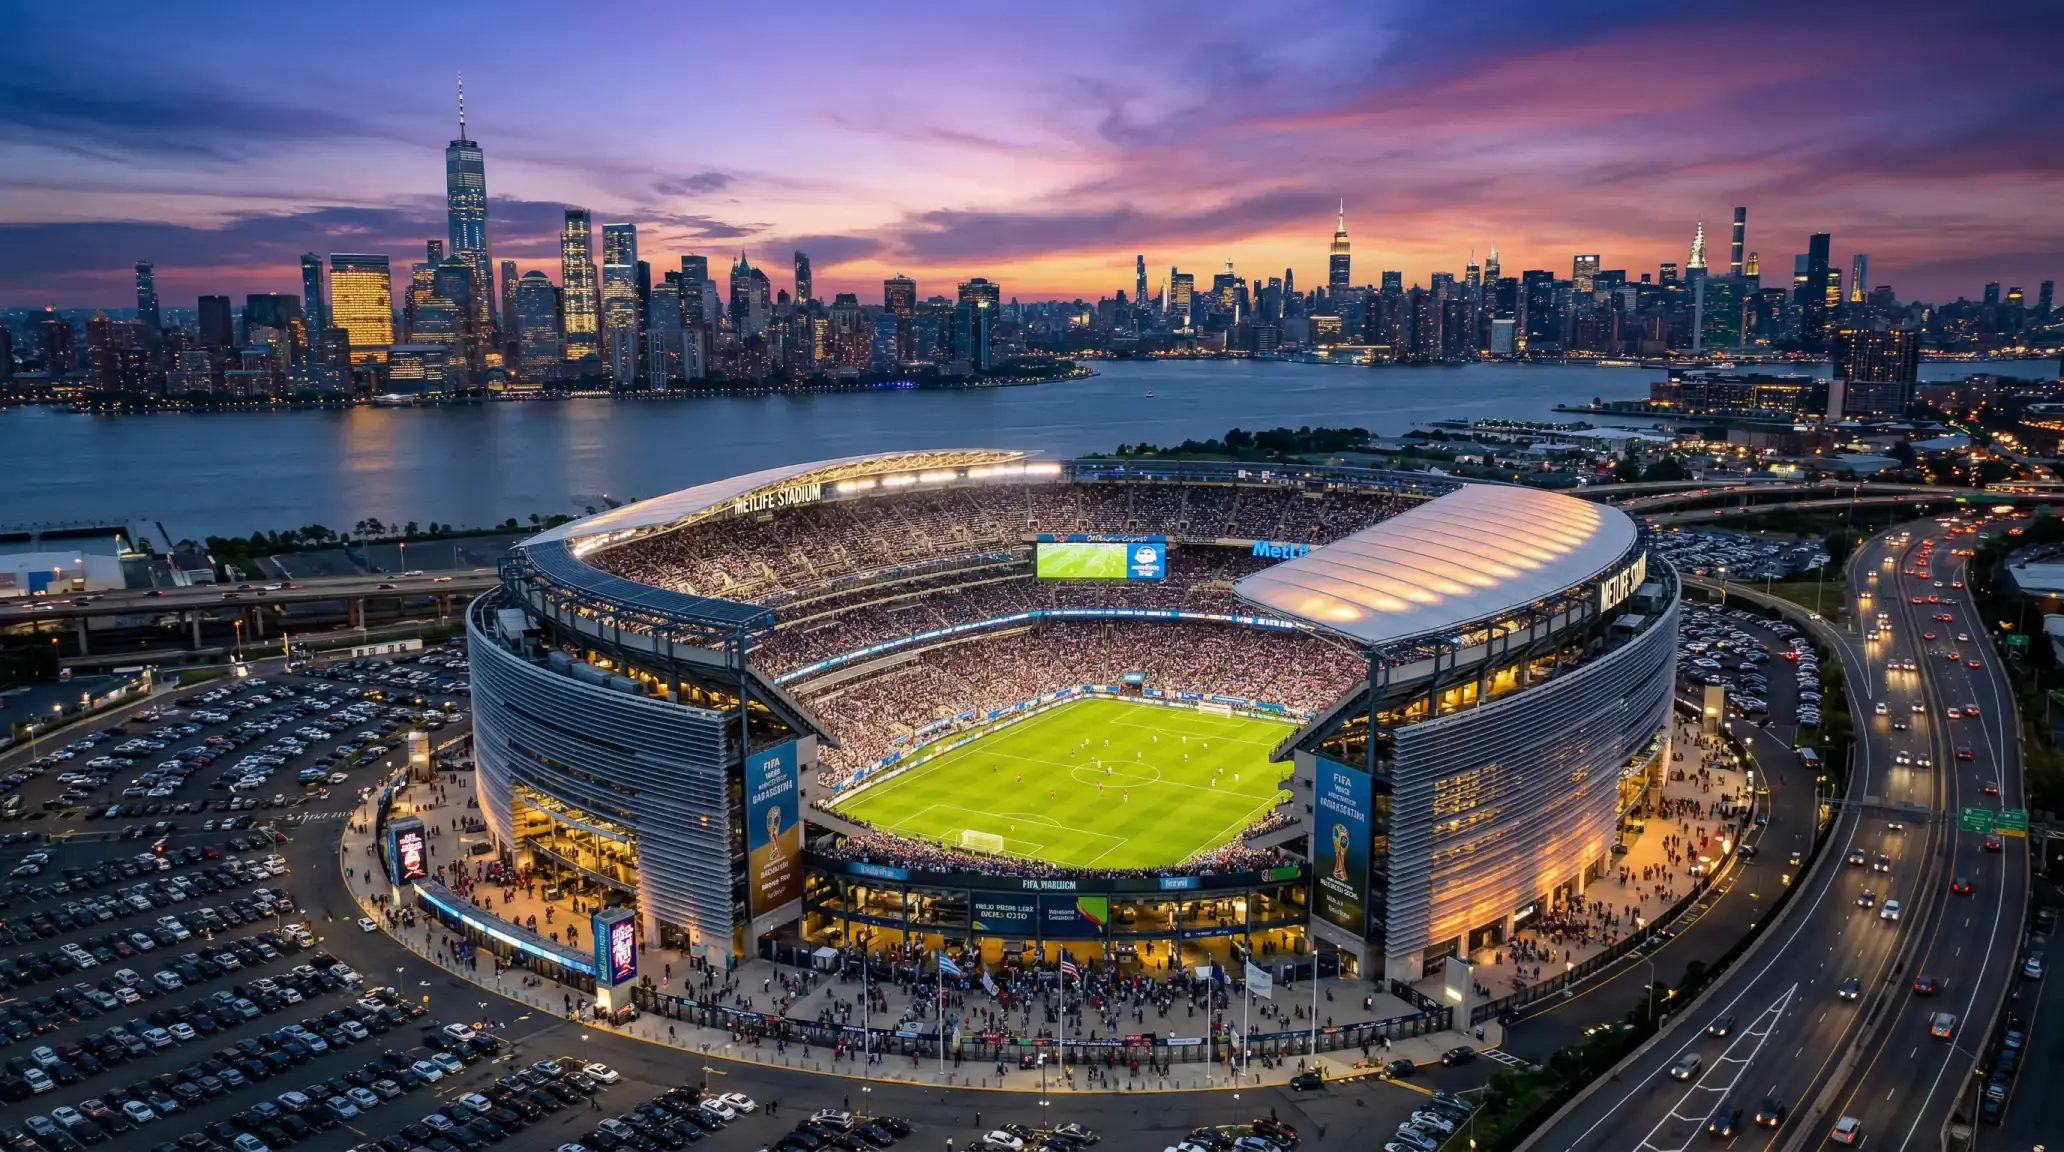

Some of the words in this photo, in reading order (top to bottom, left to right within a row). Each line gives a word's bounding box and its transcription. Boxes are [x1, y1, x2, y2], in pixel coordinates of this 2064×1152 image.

[734, 492, 775, 515] METLIFE
[777, 483, 821, 507] STADIUM
[1333, 772, 1352, 787] FIFA
[1022, 879, 1039, 889] FIFA
